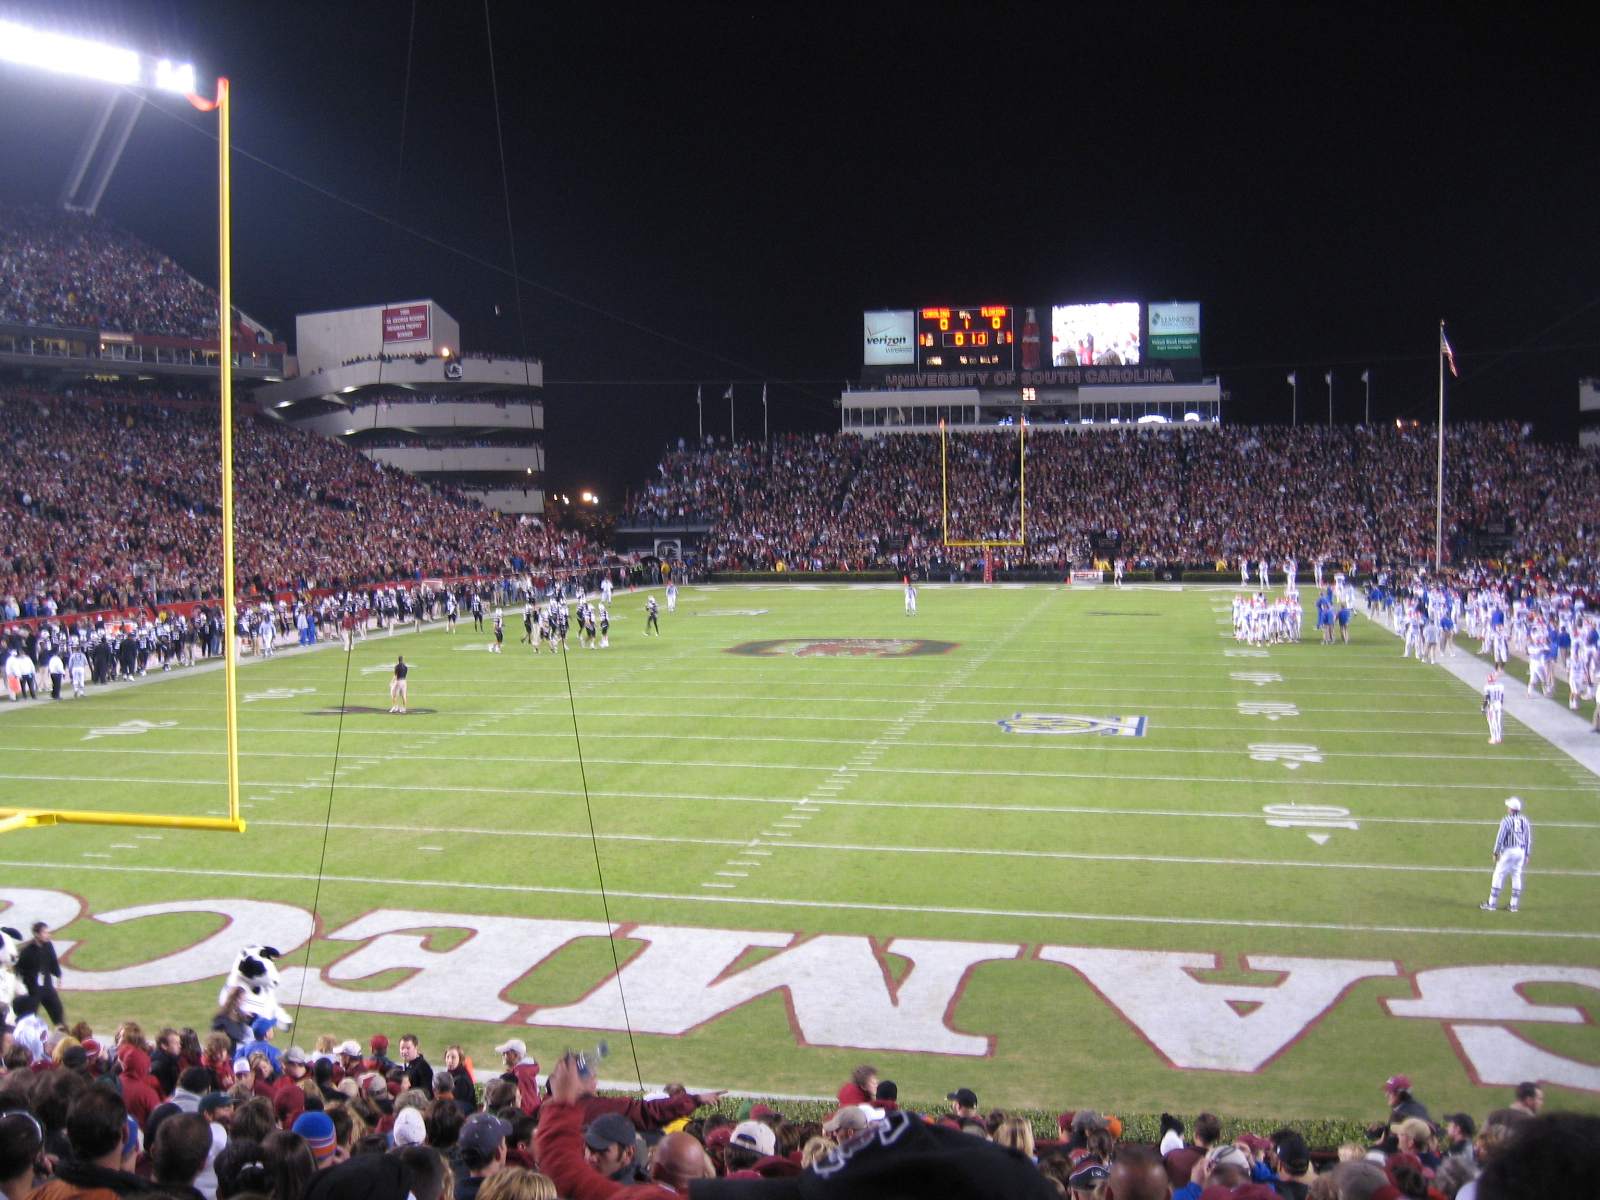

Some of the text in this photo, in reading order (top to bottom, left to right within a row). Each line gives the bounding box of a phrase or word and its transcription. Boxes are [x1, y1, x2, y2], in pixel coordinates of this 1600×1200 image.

[981, 306, 1006, 317] FLORIDA
[940, 318, 949, 330] 0
[992, 317, 1001, 329] 0
[867, 335, 906, 346] verizon
[885, 369, 1175, 388] UNIVERSITY OF SOUTH CAROLINA
[1262, 804, 1359, 830] 10
